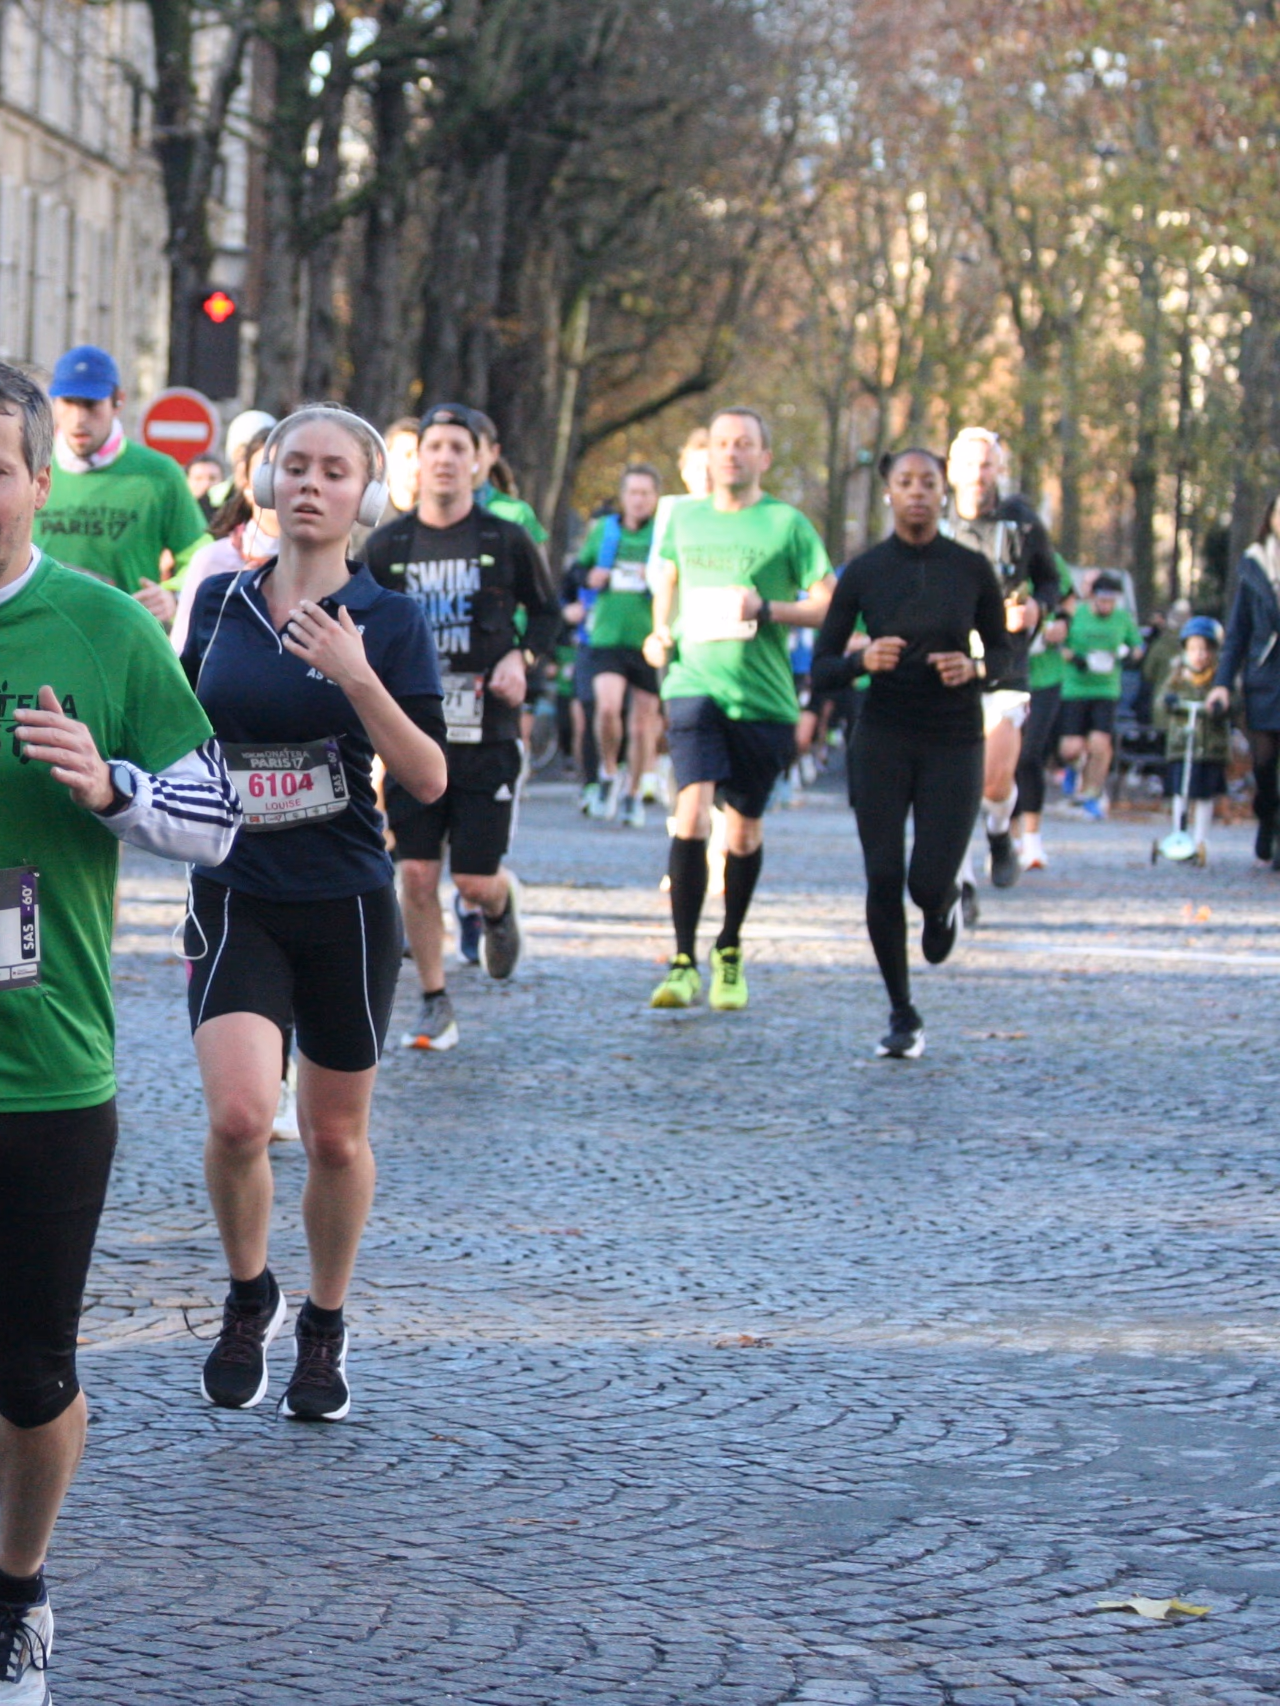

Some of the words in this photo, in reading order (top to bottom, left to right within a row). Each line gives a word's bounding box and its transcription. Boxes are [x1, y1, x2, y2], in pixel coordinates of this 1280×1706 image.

[405, 558, 482, 593] SWIM
[433, 625, 470, 654] UN
[248, 772, 315, 798] 6104
[332, 774, 344, 793] SAS
[265, 798, 302, 812] LOUISE
[23, 923, 35, 950] SAS
